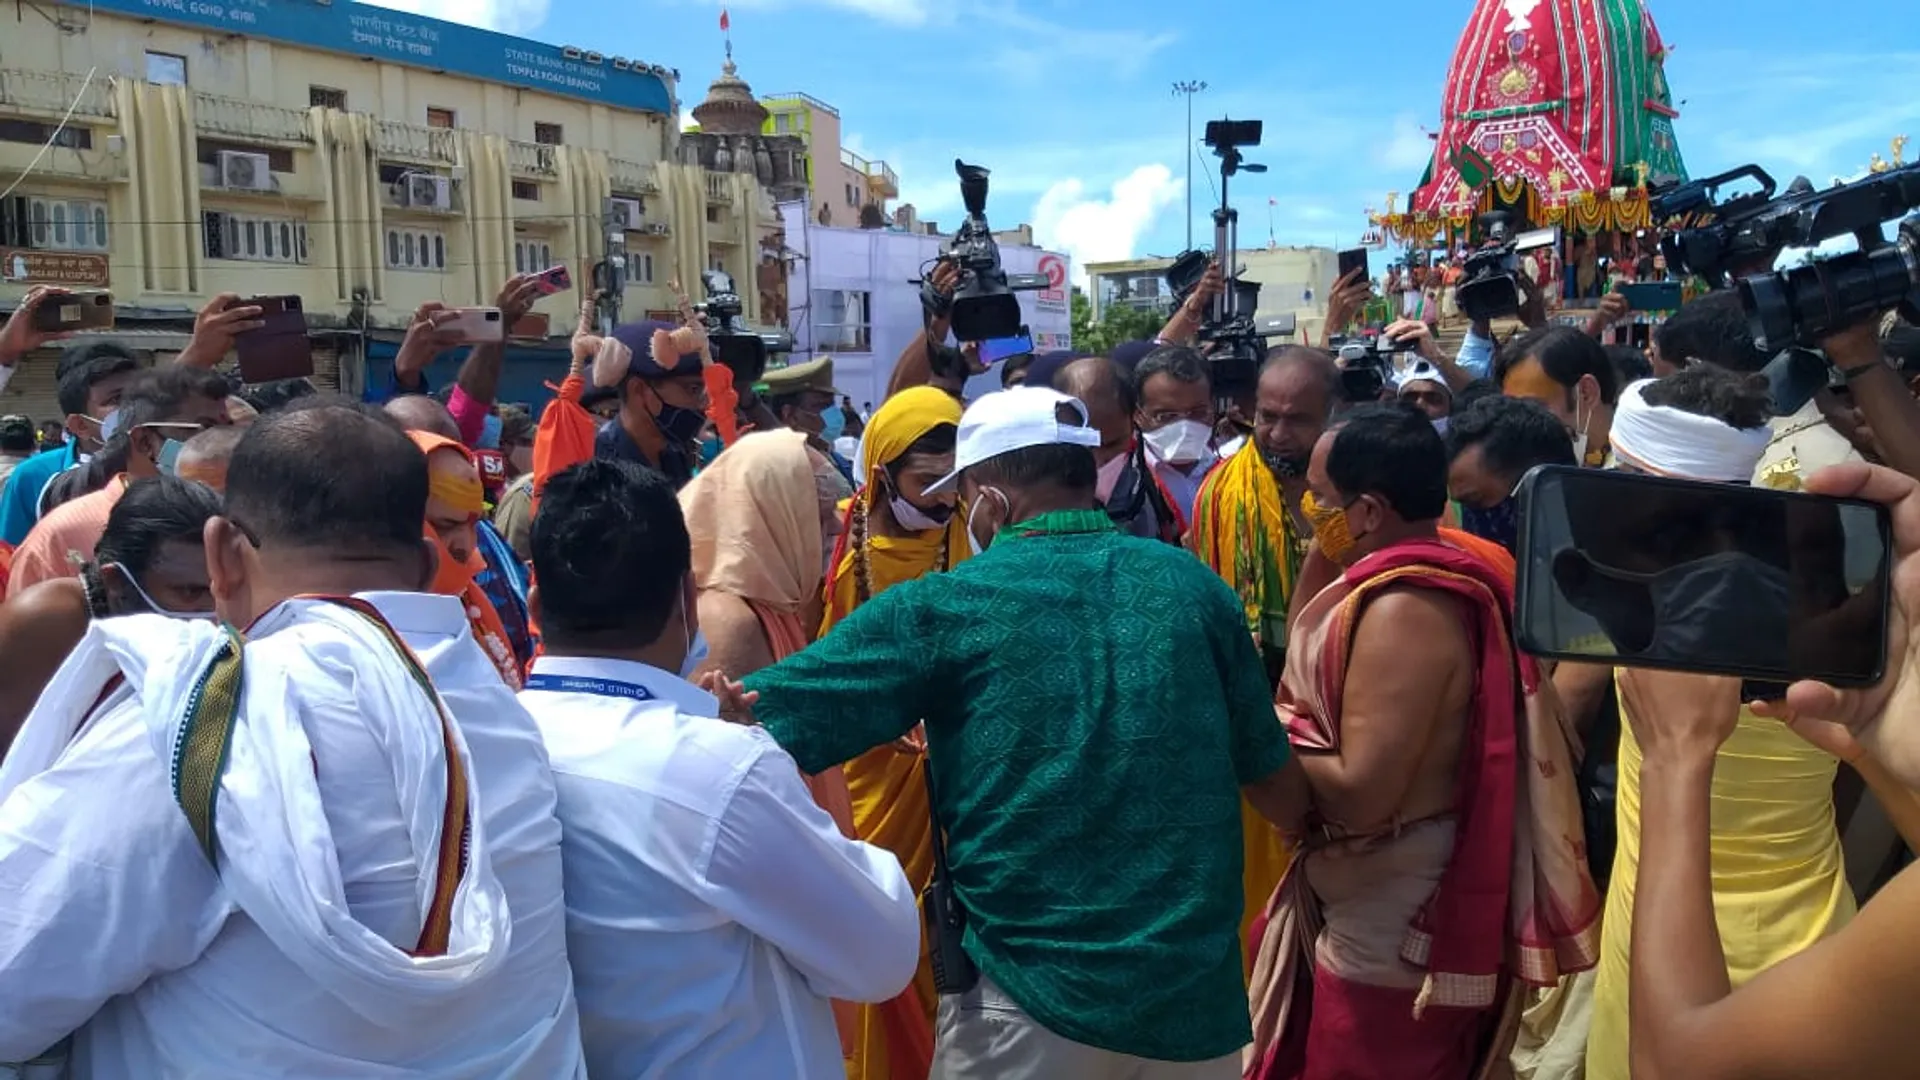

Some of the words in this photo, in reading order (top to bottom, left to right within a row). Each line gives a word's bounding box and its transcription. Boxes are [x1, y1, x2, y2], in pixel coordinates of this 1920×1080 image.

[504, 48, 535, 63] STATE
[536, 55, 563, 69] BANK
[564, 62, 578, 72] OF
[580, 65, 607, 80] INDIA
[506, 63, 539, 80] TEMPLE
[541, 71, 565, 85] ROAD
[567, 76, 602, 92] BRANCH
